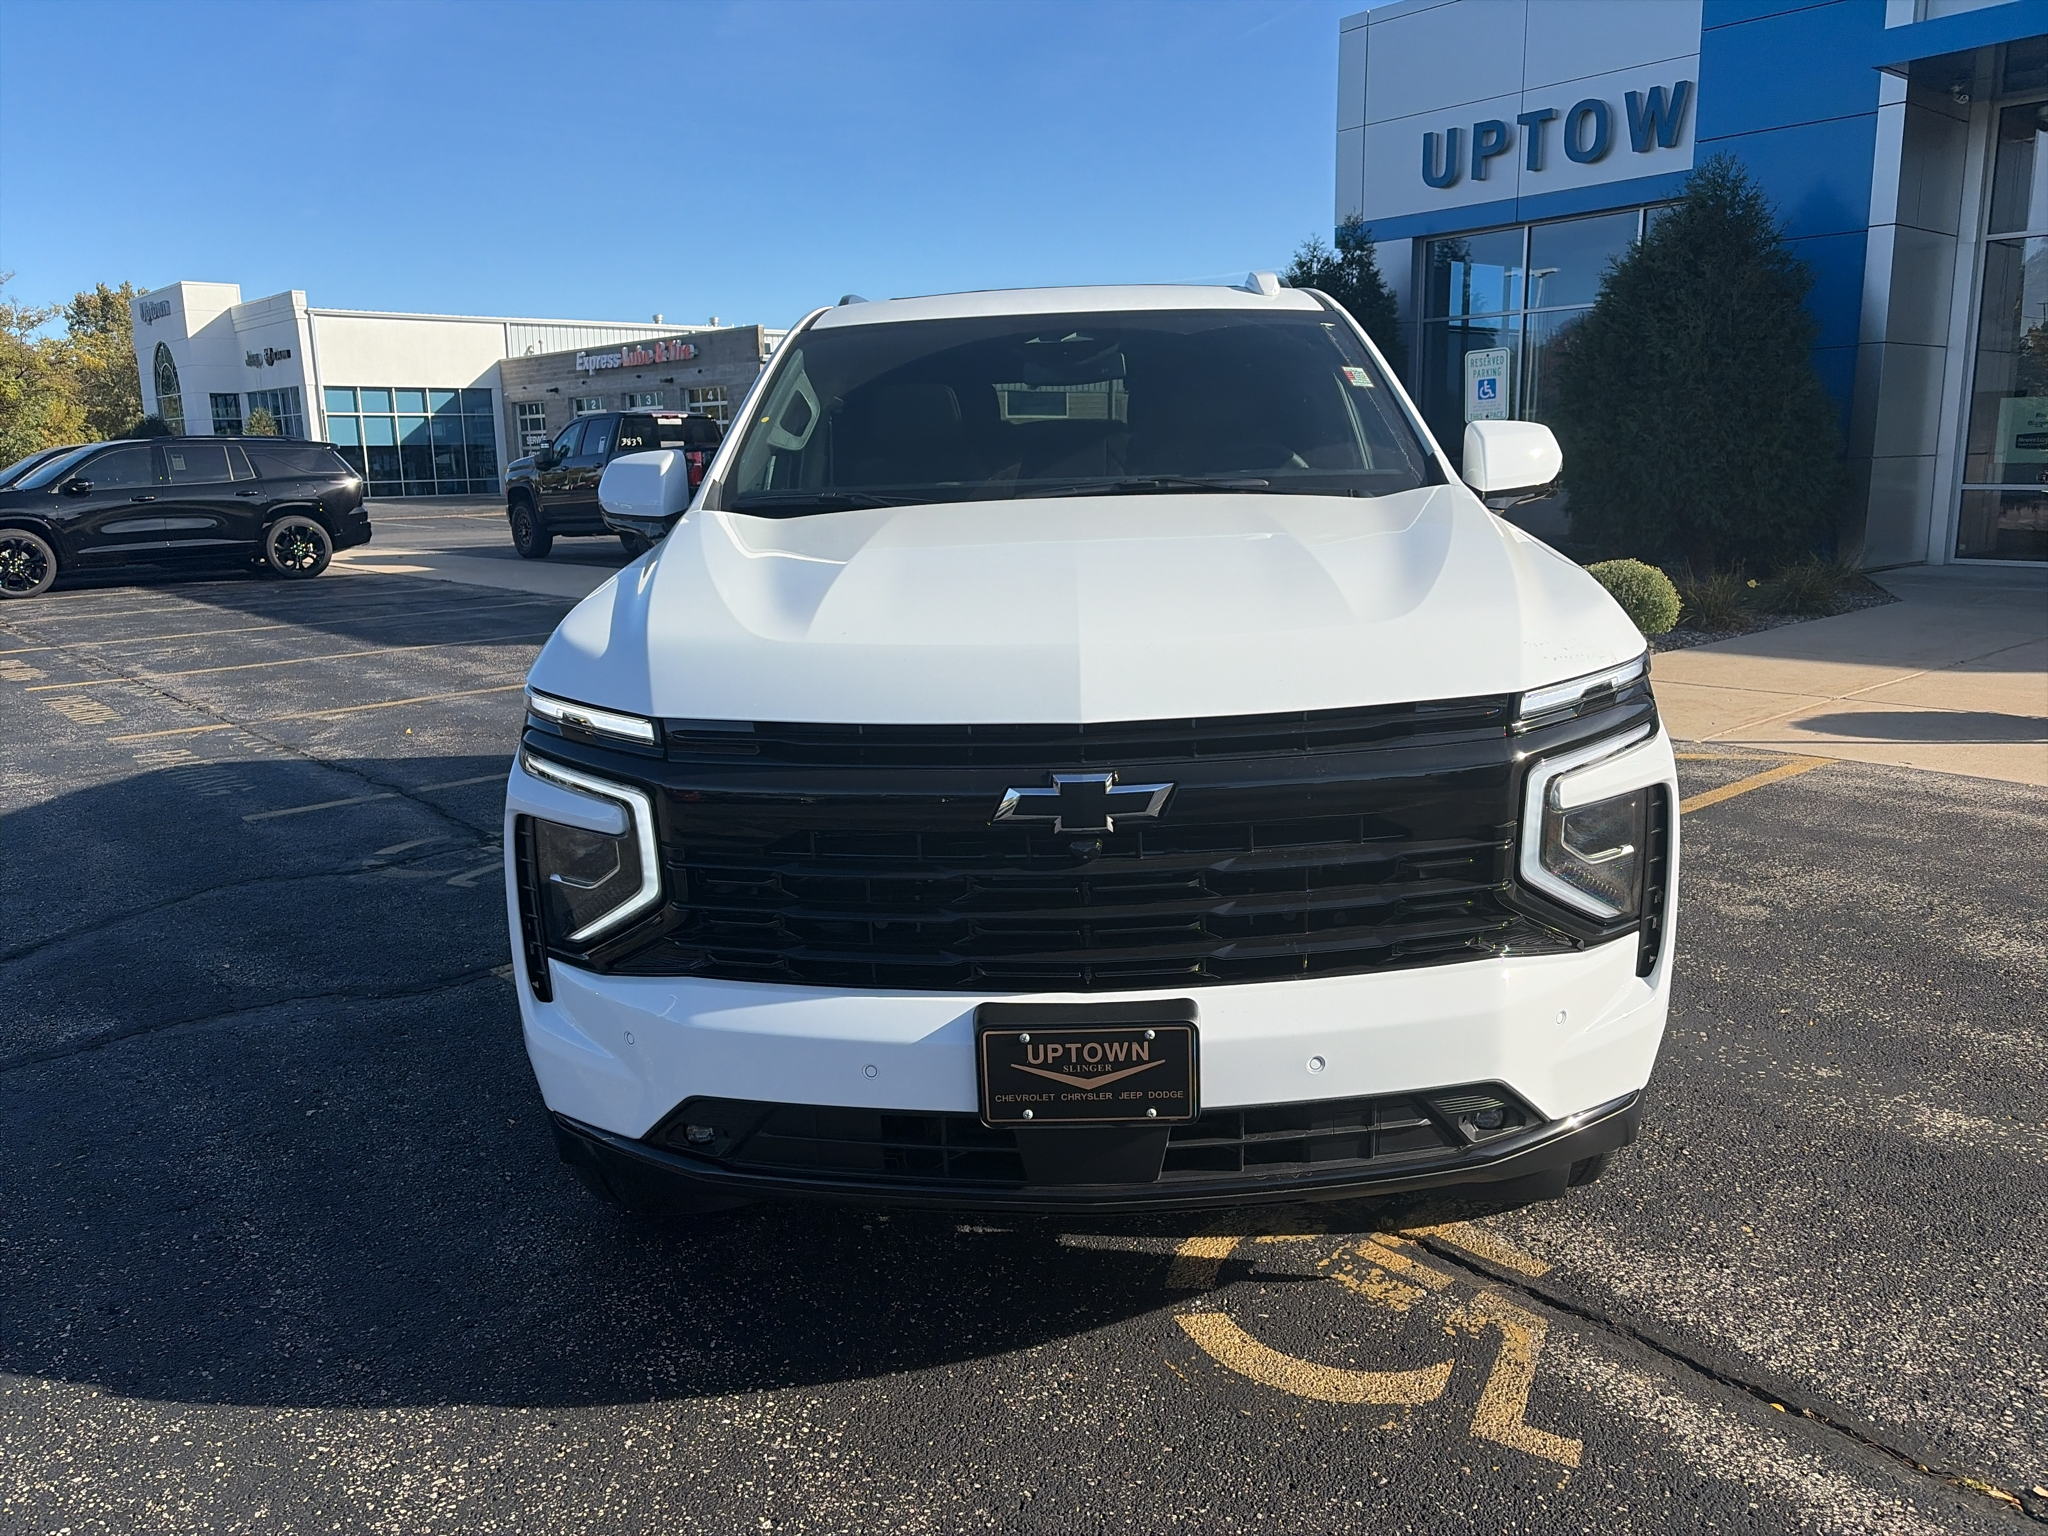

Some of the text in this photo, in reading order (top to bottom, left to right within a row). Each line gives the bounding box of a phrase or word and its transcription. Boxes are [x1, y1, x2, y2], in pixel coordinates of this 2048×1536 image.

[1421, 79, 1693, 189] UPTOW
[576, 339, 694, 376] Express Lube & Tire
[1470, 356, 1504, 367] RESERVED
[1473, 368, 1501, 378] PARKING
[645, 395, 652, 405] 3
[707, 390, 714, 400] 4
[591, 400, 597, 409] 2
[621, 436, 643, 446] 3839
[1027, 1041, 1149, 1064] UPTOWN
[1062, 1063, 1113, 1073] SLINGER
[995, 1090, 1184, 1103] CHEVROLET CHRYSLER JEEP DODGE
